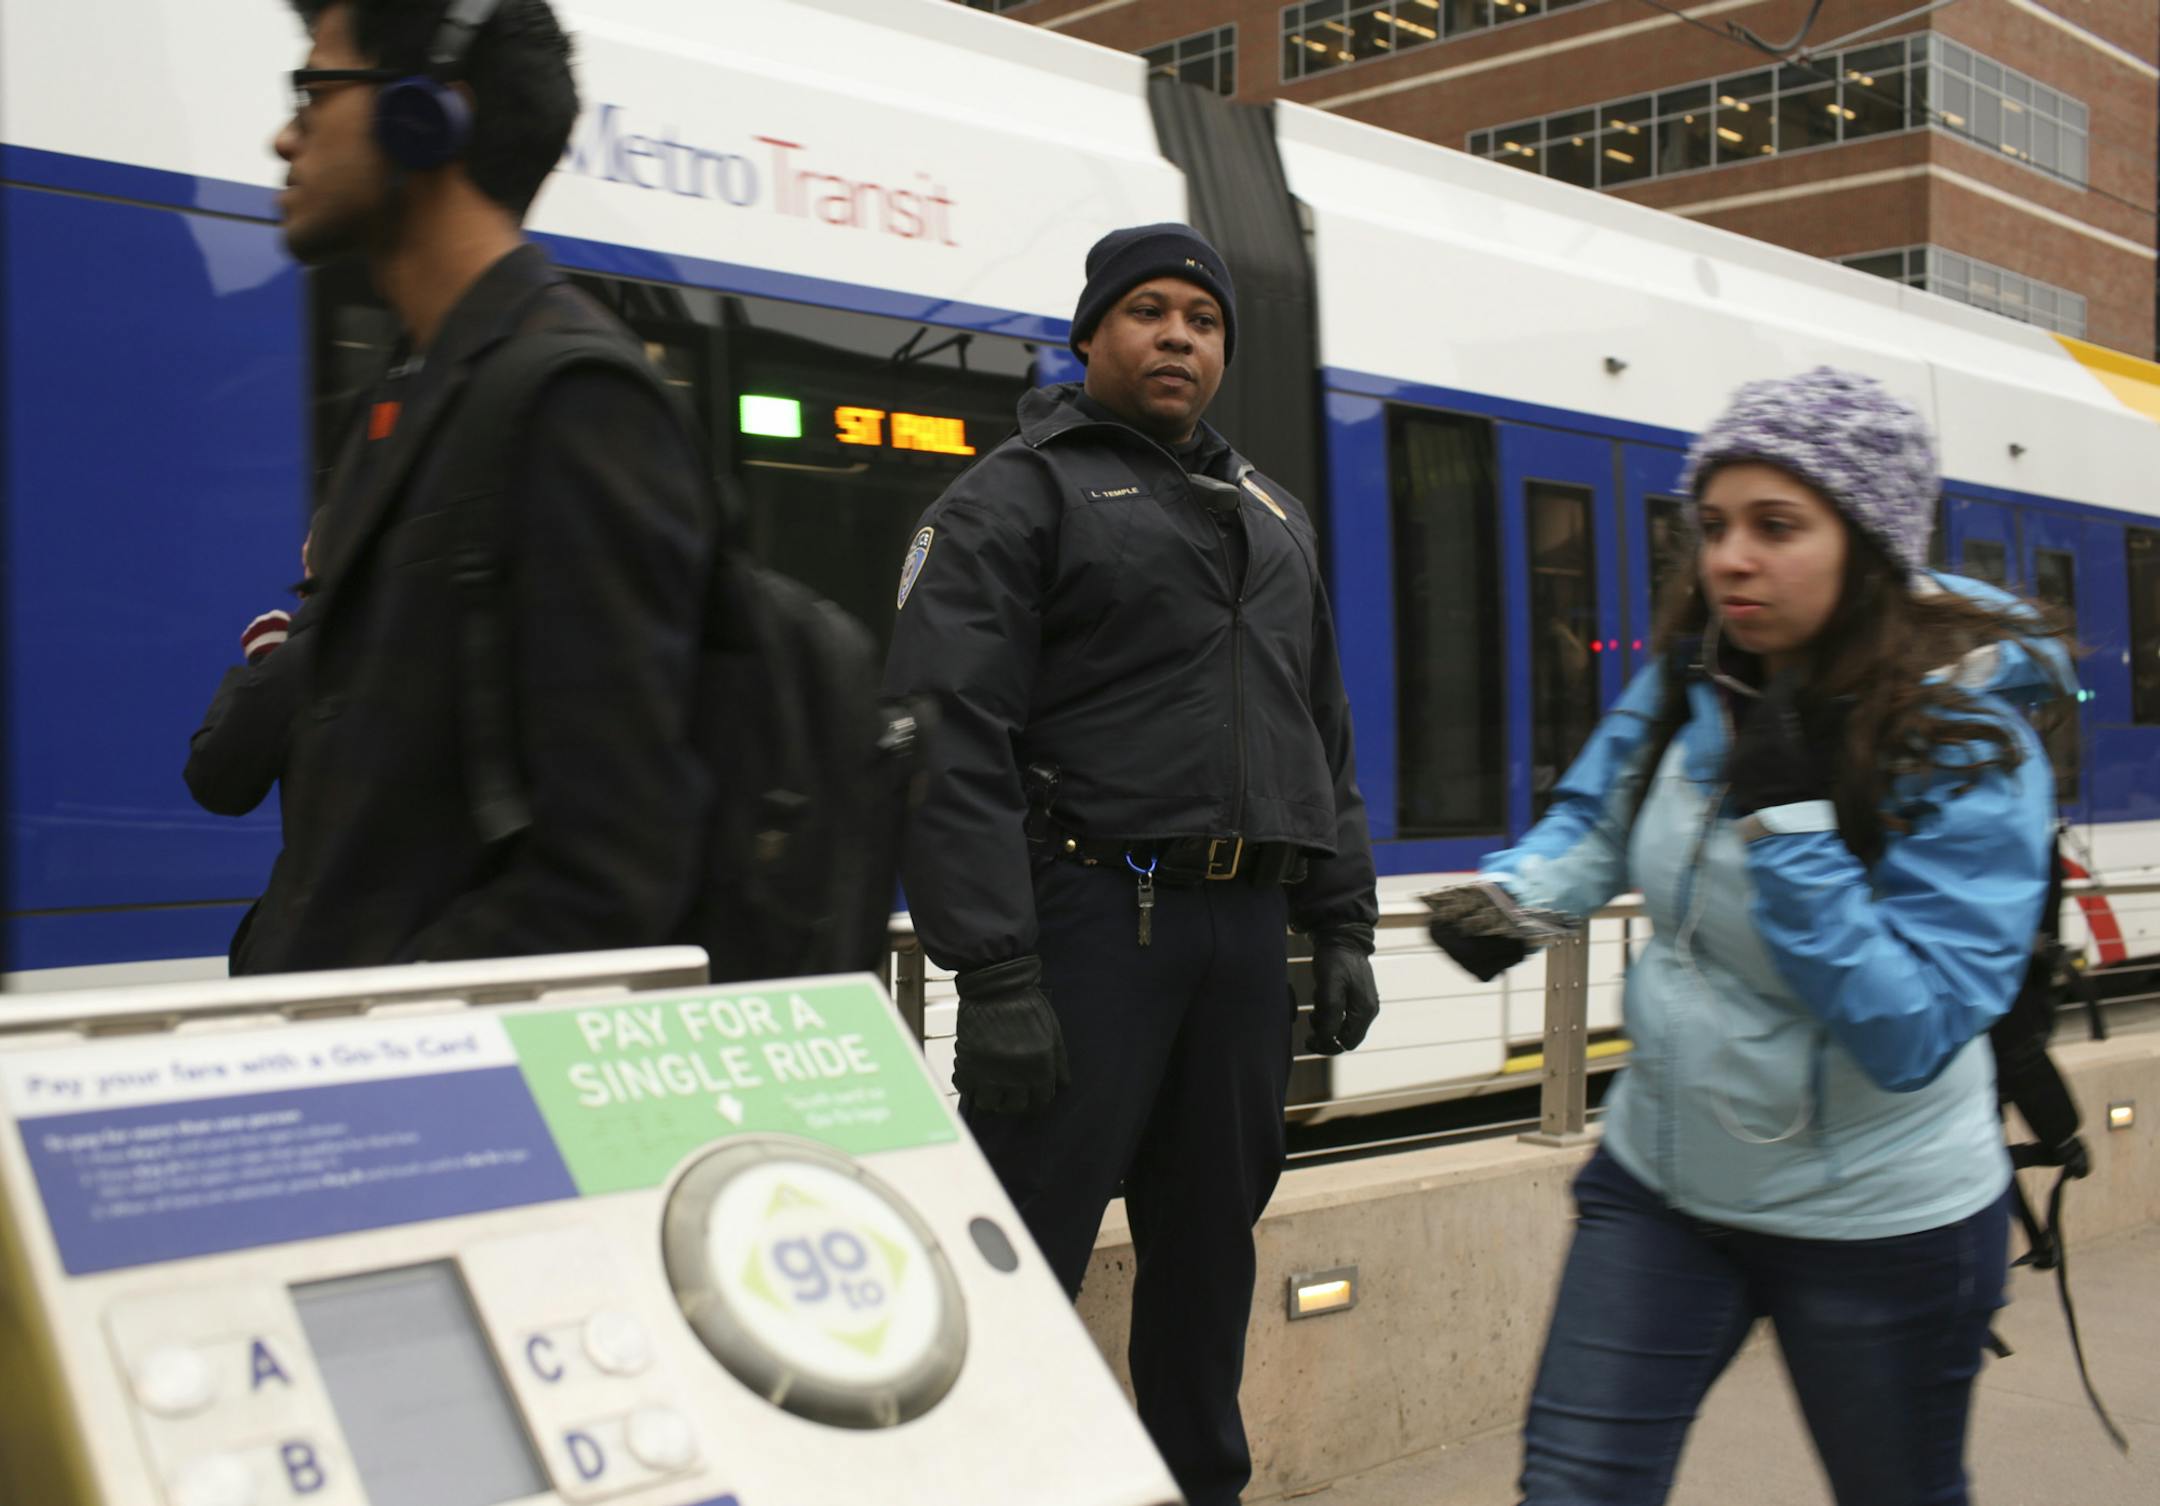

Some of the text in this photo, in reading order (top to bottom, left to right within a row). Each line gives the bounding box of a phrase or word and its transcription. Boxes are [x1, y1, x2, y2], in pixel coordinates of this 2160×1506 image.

[575, 992, 827, 1054] PAY FOR A
[27, 1074, 82, 1098] Pay
[566, 1033, 881, 1109] SINGLE RIDE
[770, 1229, 868, 1304] go
[839, 1279, 885, 1311] to
[250, 1335, 294, 1391] A
[525, 1334, 566, 1384] C
[279, 1439, 327, 1495] B
[565, 1430, 607, 1482] D
